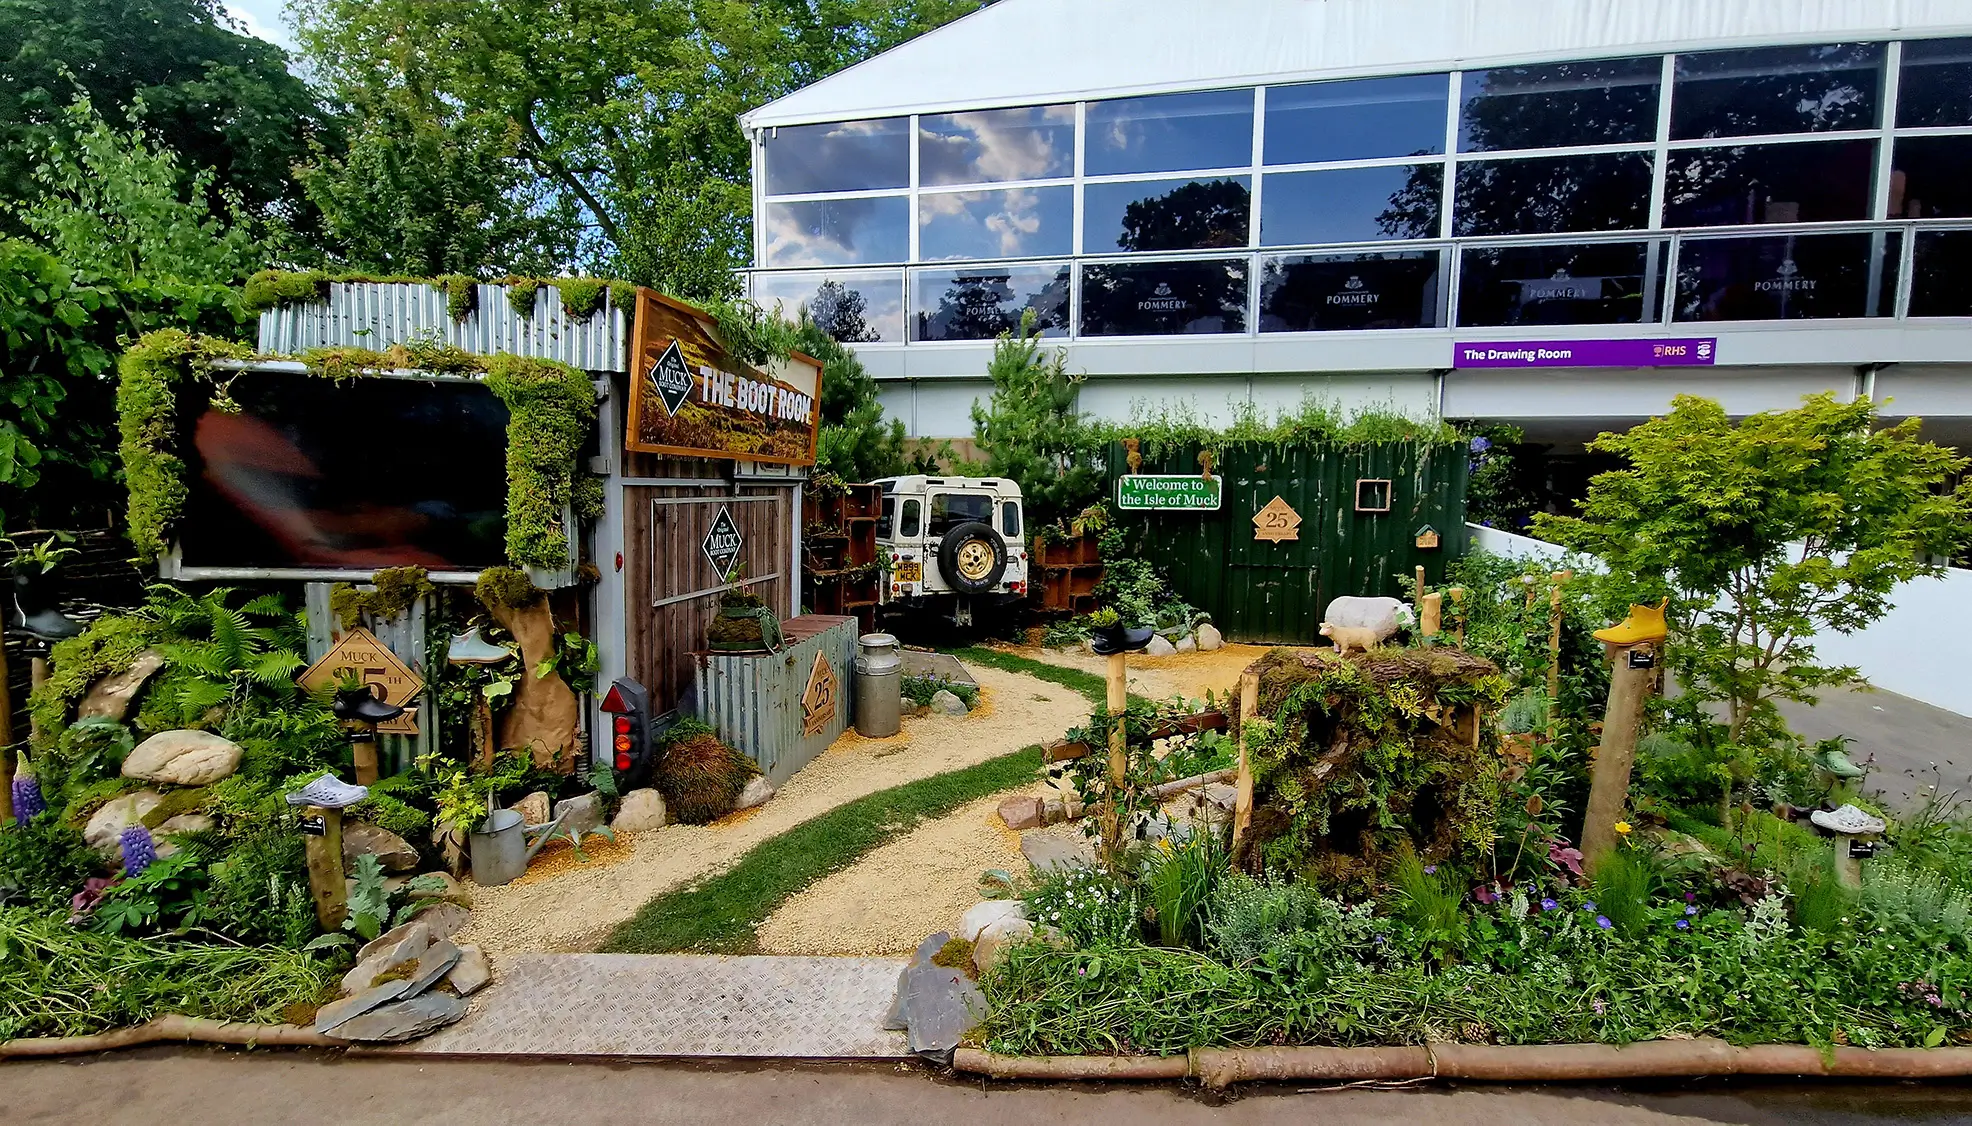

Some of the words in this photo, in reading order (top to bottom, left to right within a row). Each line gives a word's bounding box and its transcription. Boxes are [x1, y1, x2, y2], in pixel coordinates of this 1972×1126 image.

[1754, 279, 1817, 291] POMMERY
[1138, 300, 1187, 310] POMMERY
[1326, 294, 1380, 304] POMMERY
[1463, 349, 1486, 360] The
[1487, 348, 1536, 362] Drawing
[1537, 348, 1572, 359] Room
[1664, 345, 1687, 356] RHS
[659, 364, 688, 387] MUCK
[700, 365, 735, 408] THE
[737, 376, 777, 416] BOOT
[777, 388, 812, 425] ROOM
[1133, 479, 1189, 491] Welcome
[1191, 479, 1204, 491] to
[1121, 493, 1141, 505] the
[1143, 493, 1166, 505] Isle
[1168, 493, 1182, 505] of
[1183, 493, 1218, 505] Muck
[1265, 511, 1288, 528] 25
[710, 533, 738, 550] MUCK
[709, 548, 720, 556] BOOT
[719, 547, 737, 556] COMPANY
[341, 650, 378, 662] MUCK
[814, 676, 830, 711] 25
